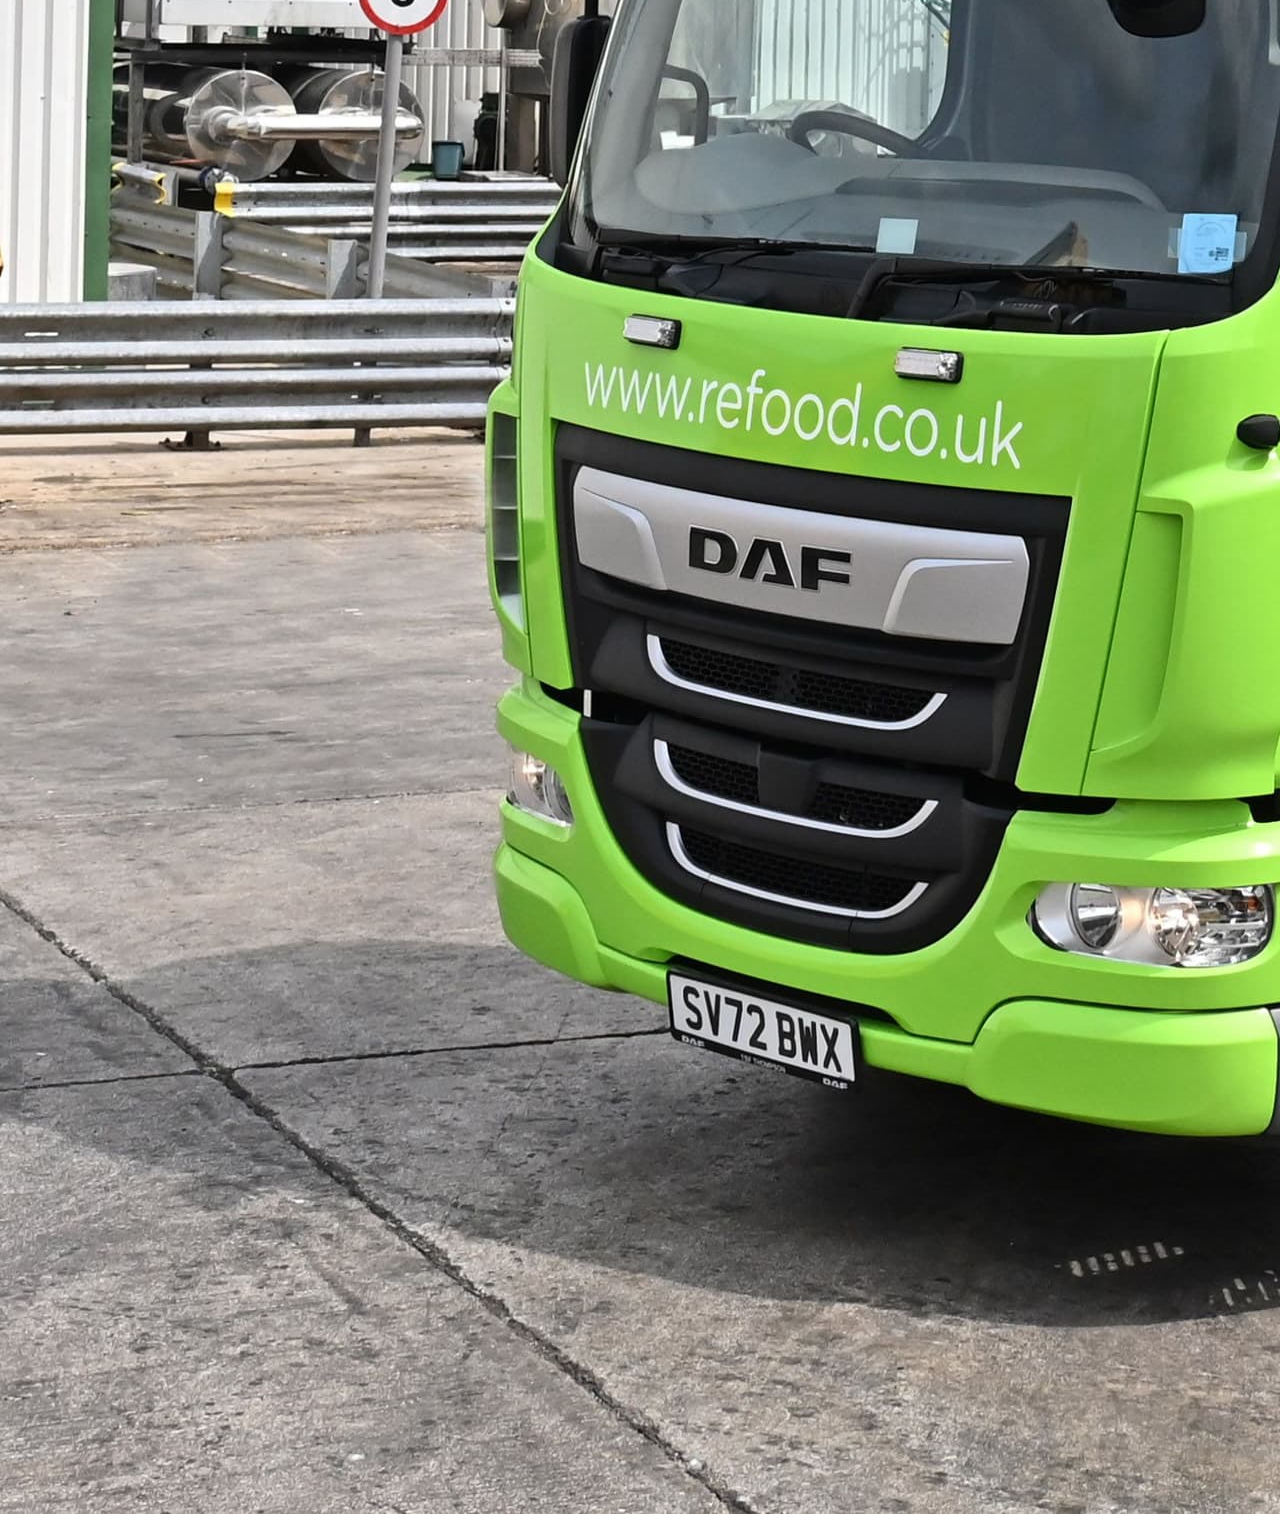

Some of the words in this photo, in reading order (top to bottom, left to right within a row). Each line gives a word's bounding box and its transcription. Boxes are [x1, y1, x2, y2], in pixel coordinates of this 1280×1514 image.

[584, 361, 1024, 470] www.refood.co.uk
[688, 525, 853, 592] DAF
[682, 985, 768, 1051] SV72
[775, 1010, 843, 1074] BWX
[822, 1077, 849, 1090] DAF
